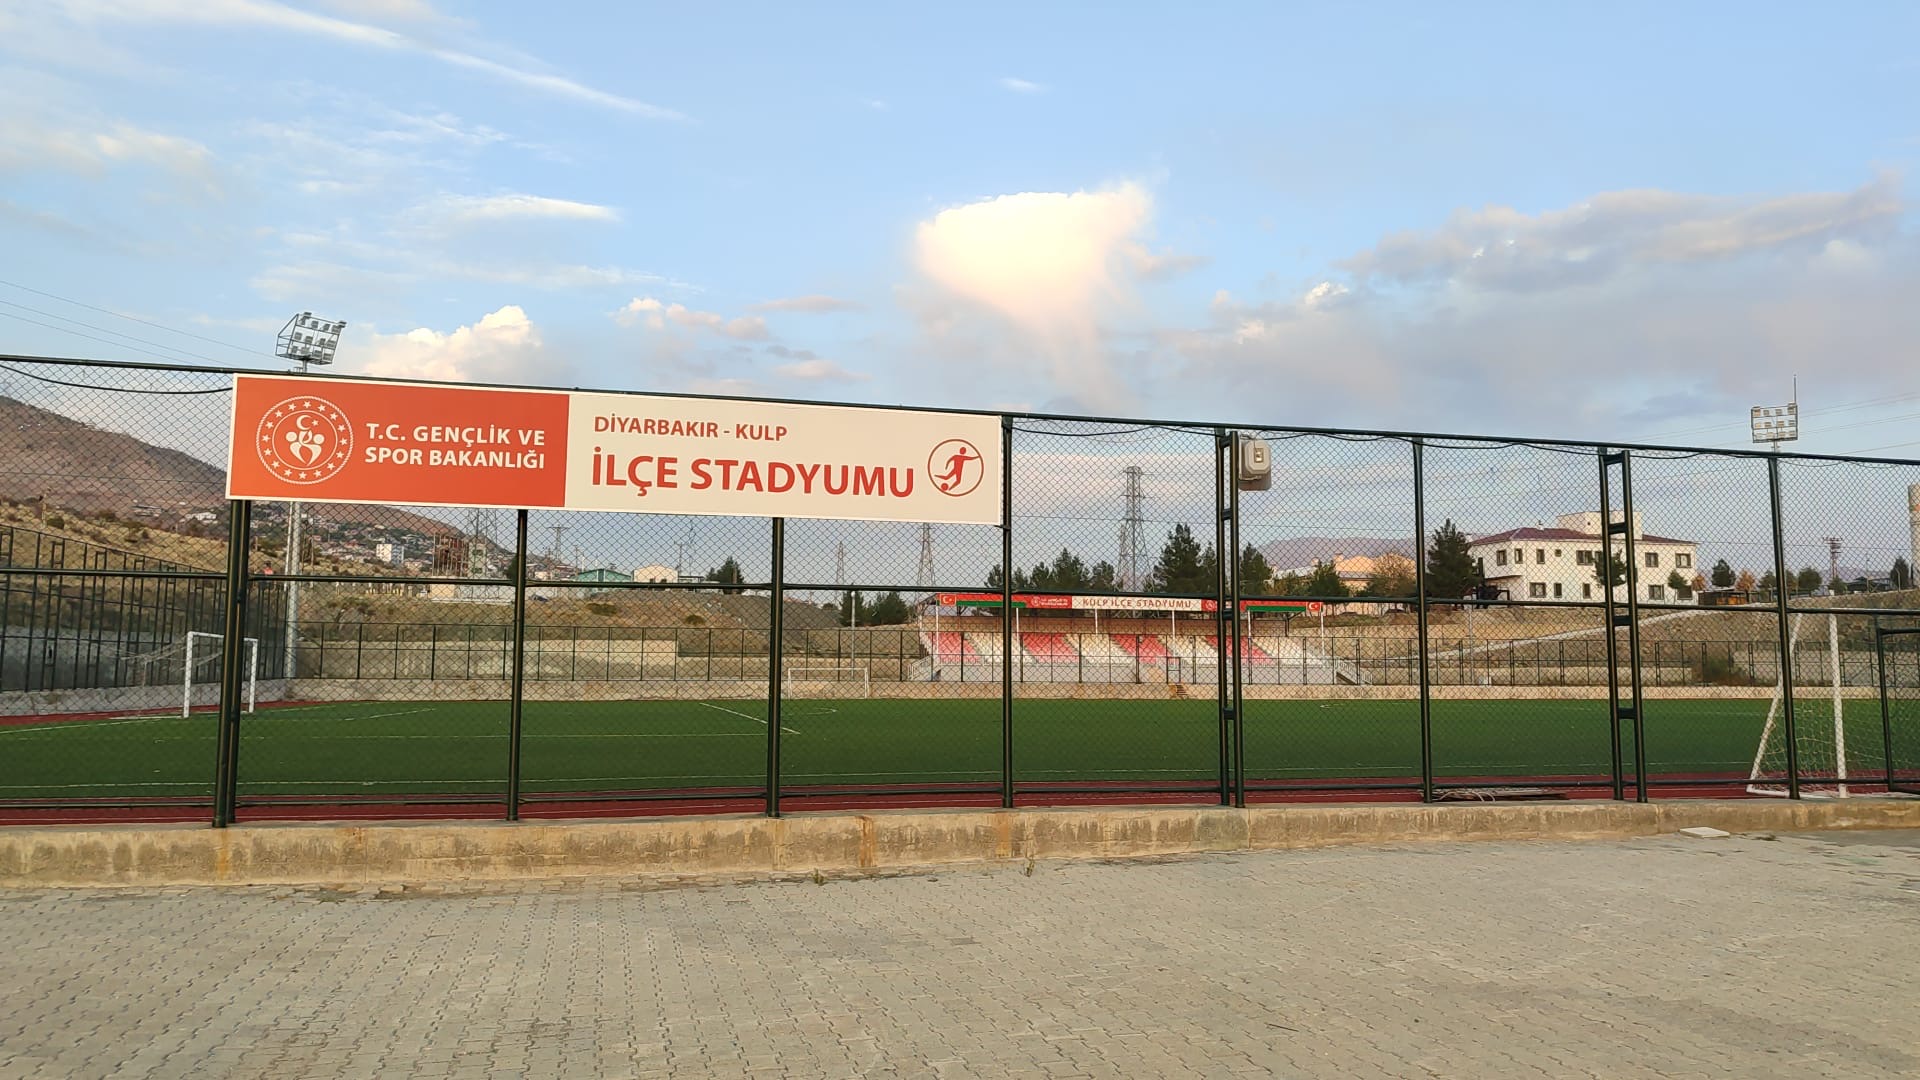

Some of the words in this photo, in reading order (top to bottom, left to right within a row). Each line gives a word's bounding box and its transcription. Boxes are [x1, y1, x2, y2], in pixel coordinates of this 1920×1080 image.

[366, 422, 406, 441] T.C.
[413, 423, 510, 447] GENÇLİK
[517, 429, 546, 446] VE
[594, 413, 718, 438] DİYARBAKIR
[735, 424, 788, 441] KULP
[365, 446, 424, 465] SPOR
[429, 449, 546, 470] BAKANLIĞI
[592, 446, 678, 496] İLÇE
[690, 458, 914, 498] STADYUMU
[1083, 598, 1108, 607] KULP
[1136, 599, 1191, 608] STADYUMU
